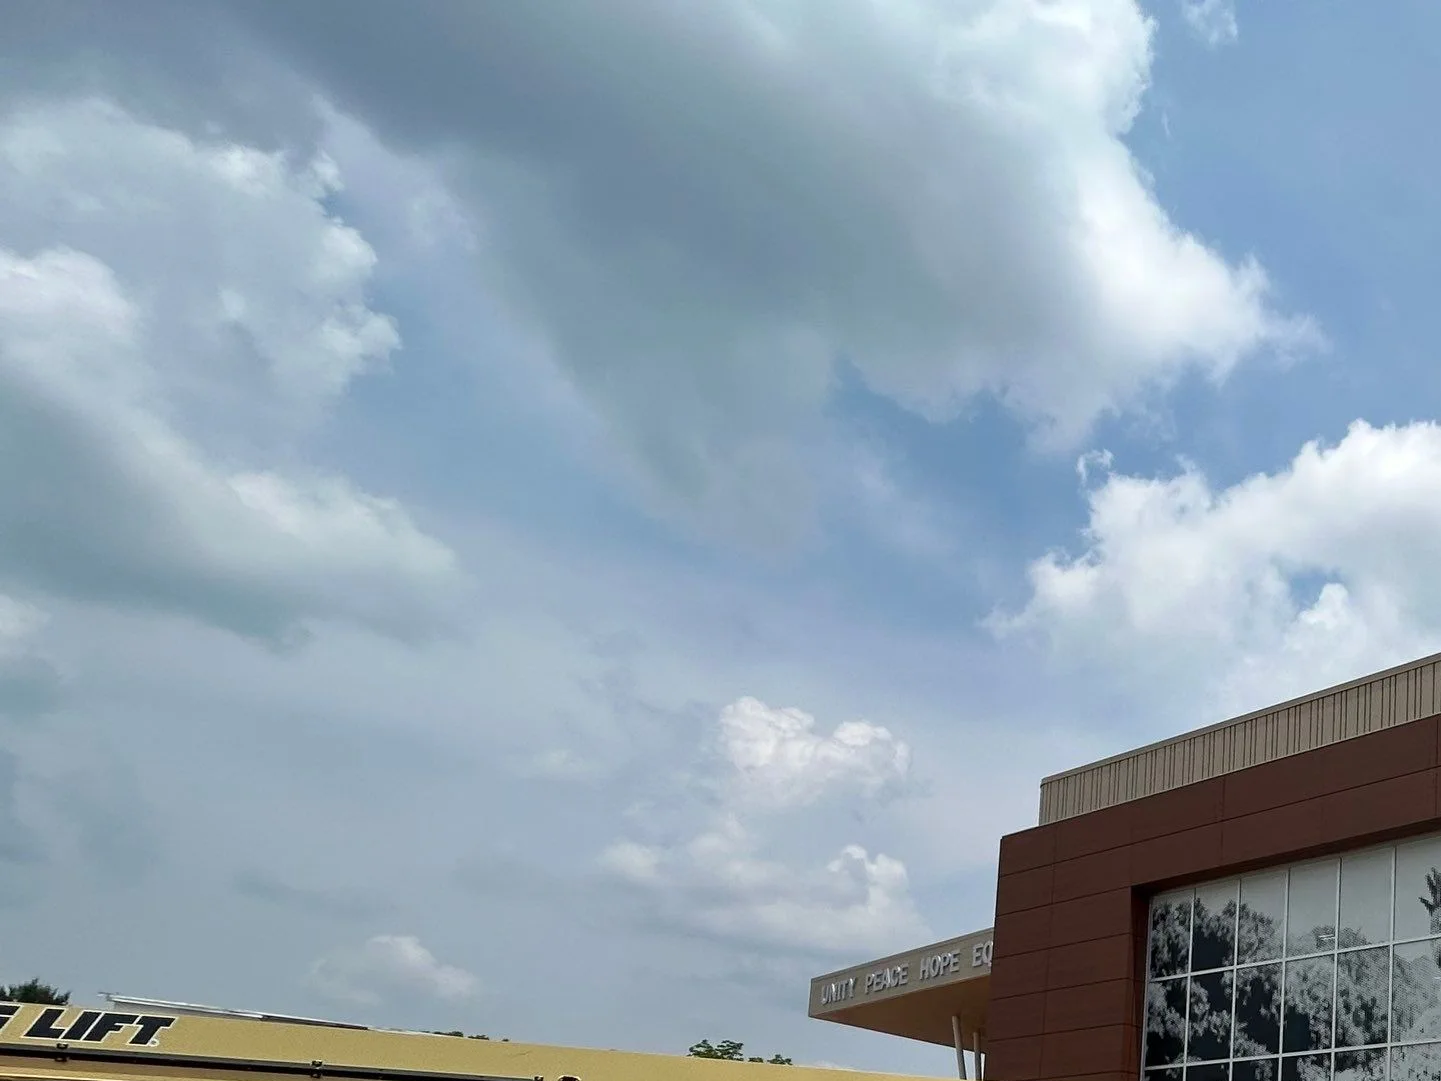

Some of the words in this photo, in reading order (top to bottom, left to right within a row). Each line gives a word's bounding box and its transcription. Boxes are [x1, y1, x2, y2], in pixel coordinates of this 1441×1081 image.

[821, 977, 857, 1004] UNITY
[864, 963, 910, 994] PEACE
[919, 952, 961, 980] HOPE
[22, 1007, 178, 1047] LIFT
